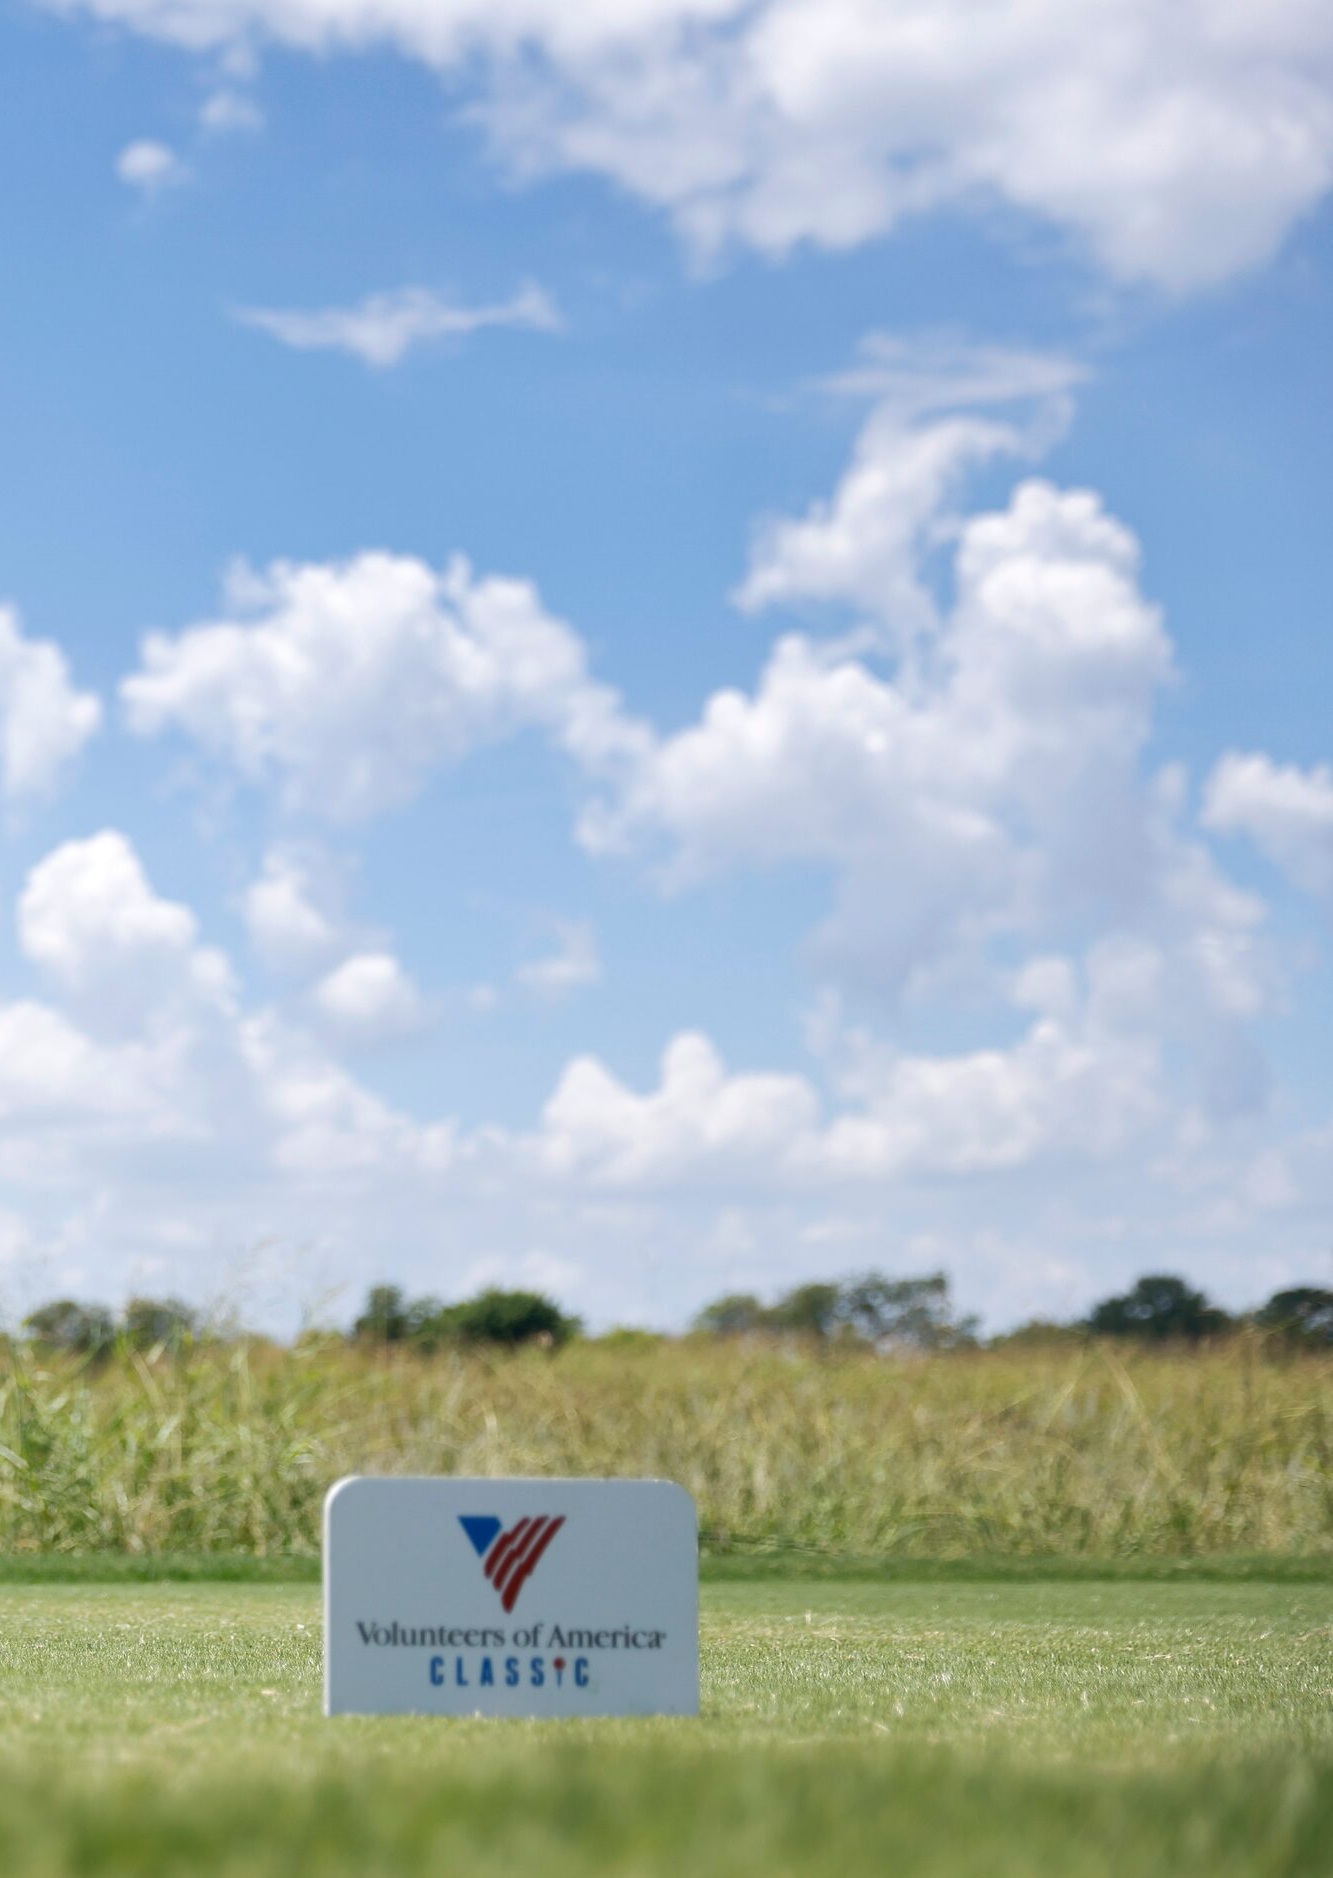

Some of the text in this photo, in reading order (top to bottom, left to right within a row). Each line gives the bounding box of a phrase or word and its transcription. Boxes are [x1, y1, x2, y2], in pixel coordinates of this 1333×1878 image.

[356, 1621, 662, 1648] Volunteers of America
[429, 1655, 591, 1688] CLASSIC
